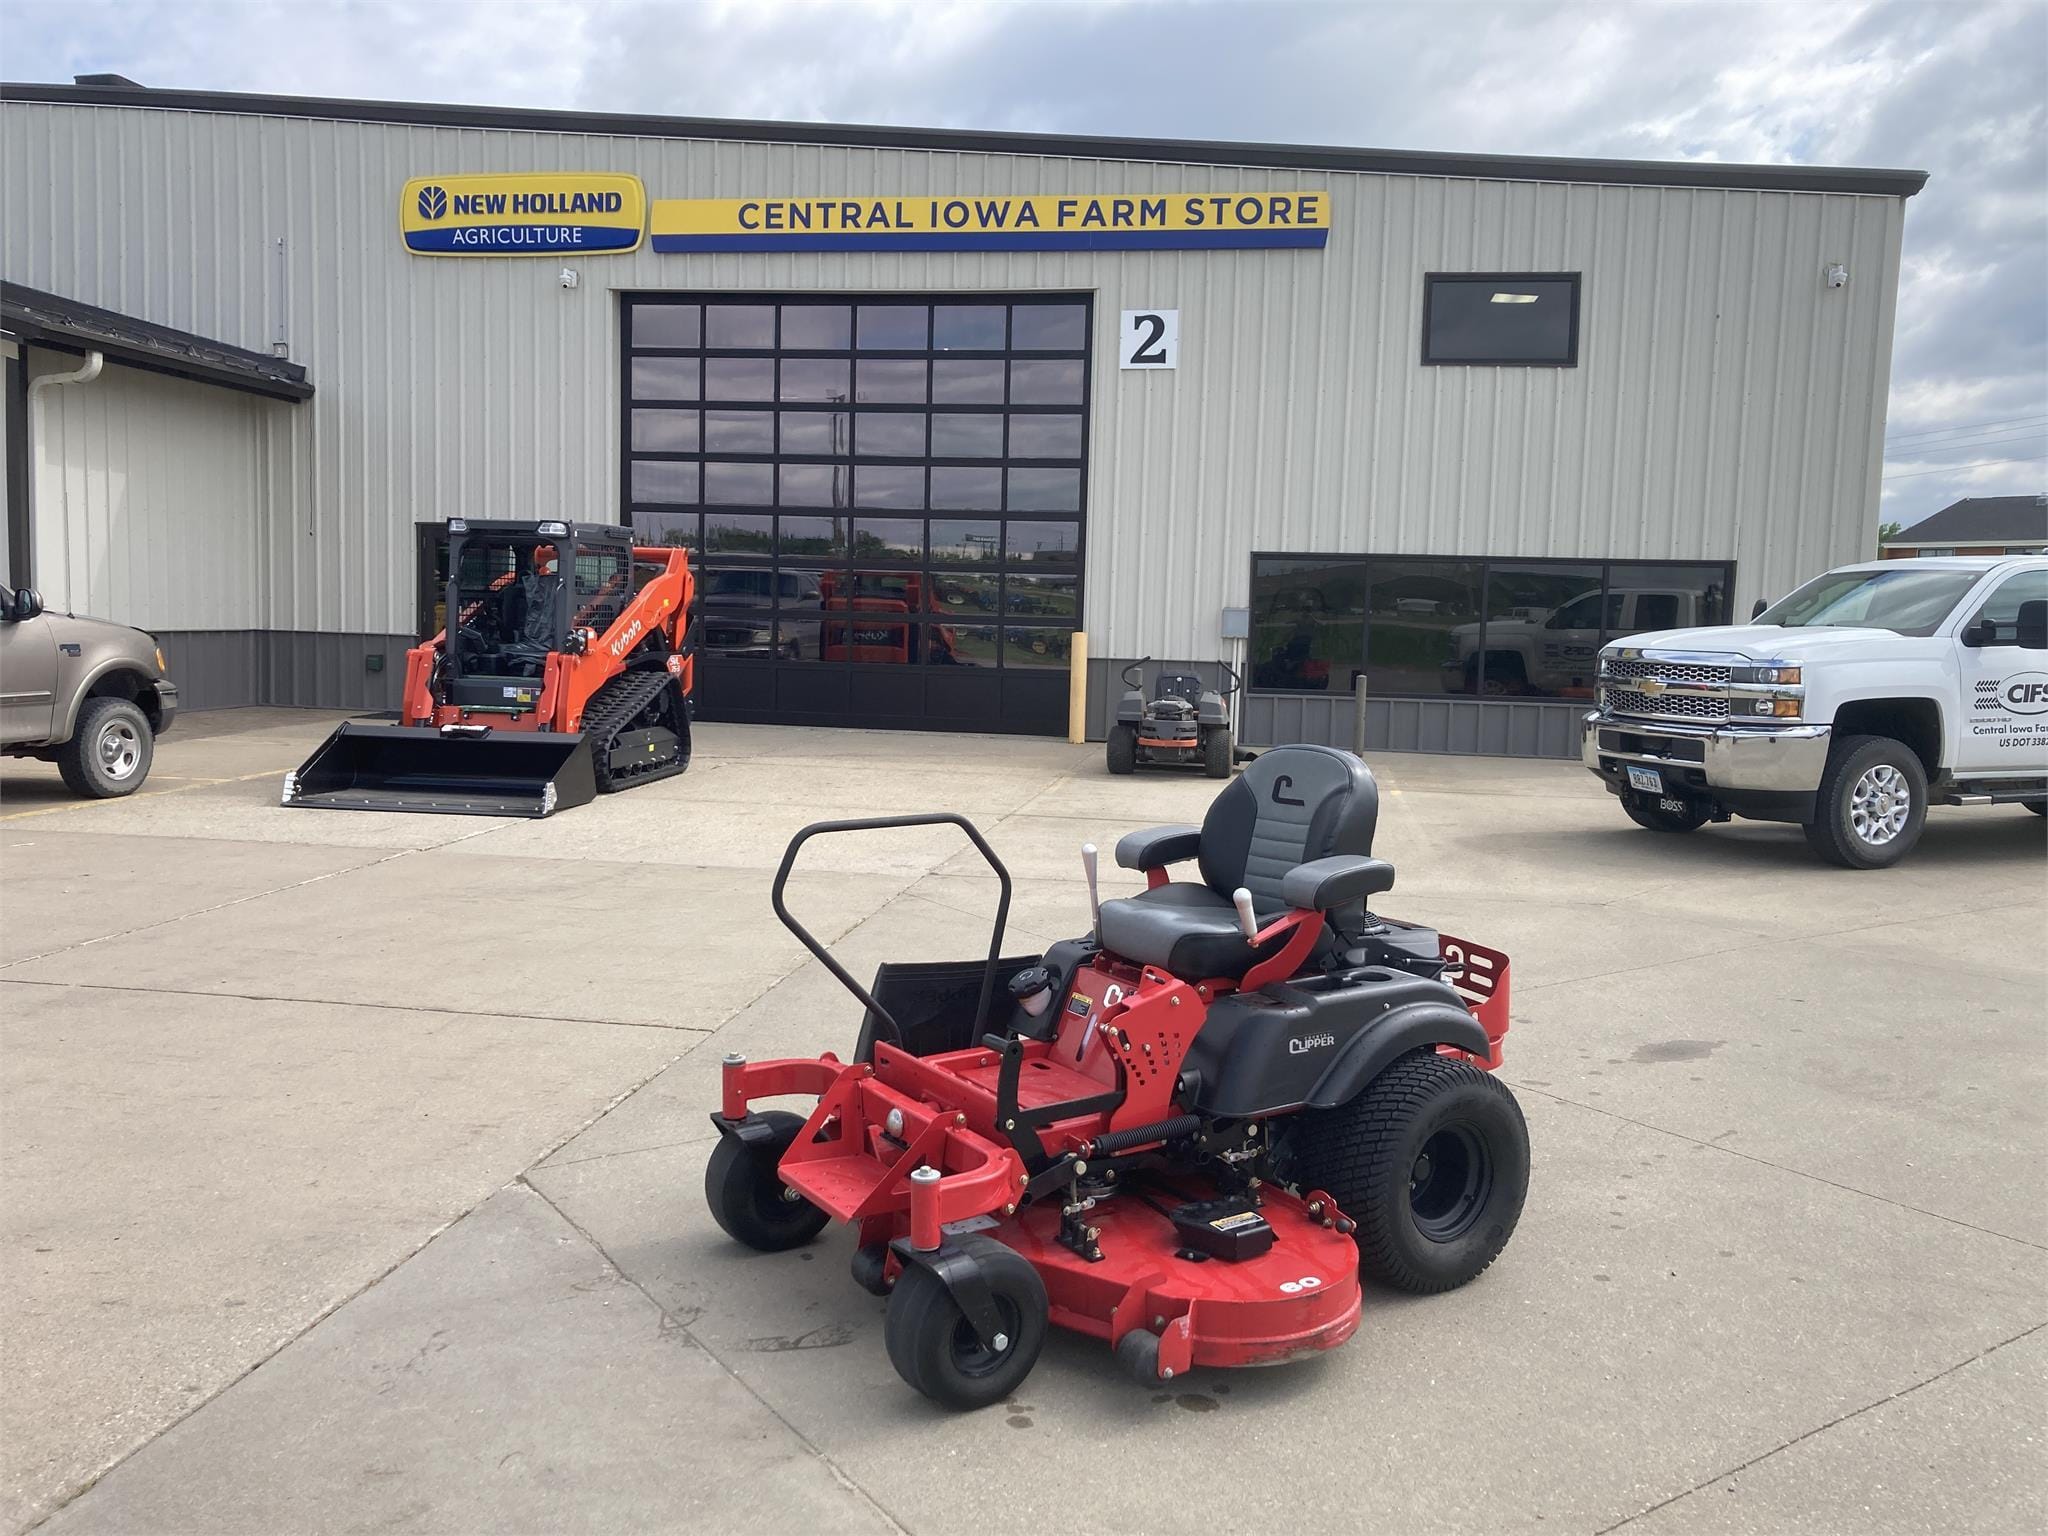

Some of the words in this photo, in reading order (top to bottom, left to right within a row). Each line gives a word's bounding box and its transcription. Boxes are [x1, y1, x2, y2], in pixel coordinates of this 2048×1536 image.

[453, 193, 507, 215] NEW
[512, 191, 622, 214] HOLLAND
[738, 201, 914, 230] CENTRAL
[930, 200, 1040, 229] IOWA
[1057, 199, 1167, 228] FARM
[1184, 196, 1319, 226] STORE
[452, 227, 582, 245] AGRICULTURE
[1130, 314, 1167, 364] 2
[611, 619, 642, 656] Kubota
[1973, 724, 2007, 735] Central
[2009, 724, 2033, 734] Iowa
[1999, 738, 2011, 748] US
[2012, 738, 2032, 747] DOT
[1289, 1035, 1335, 1054] CLIPPER
[1279, 1276, 1322, 1294] 60
